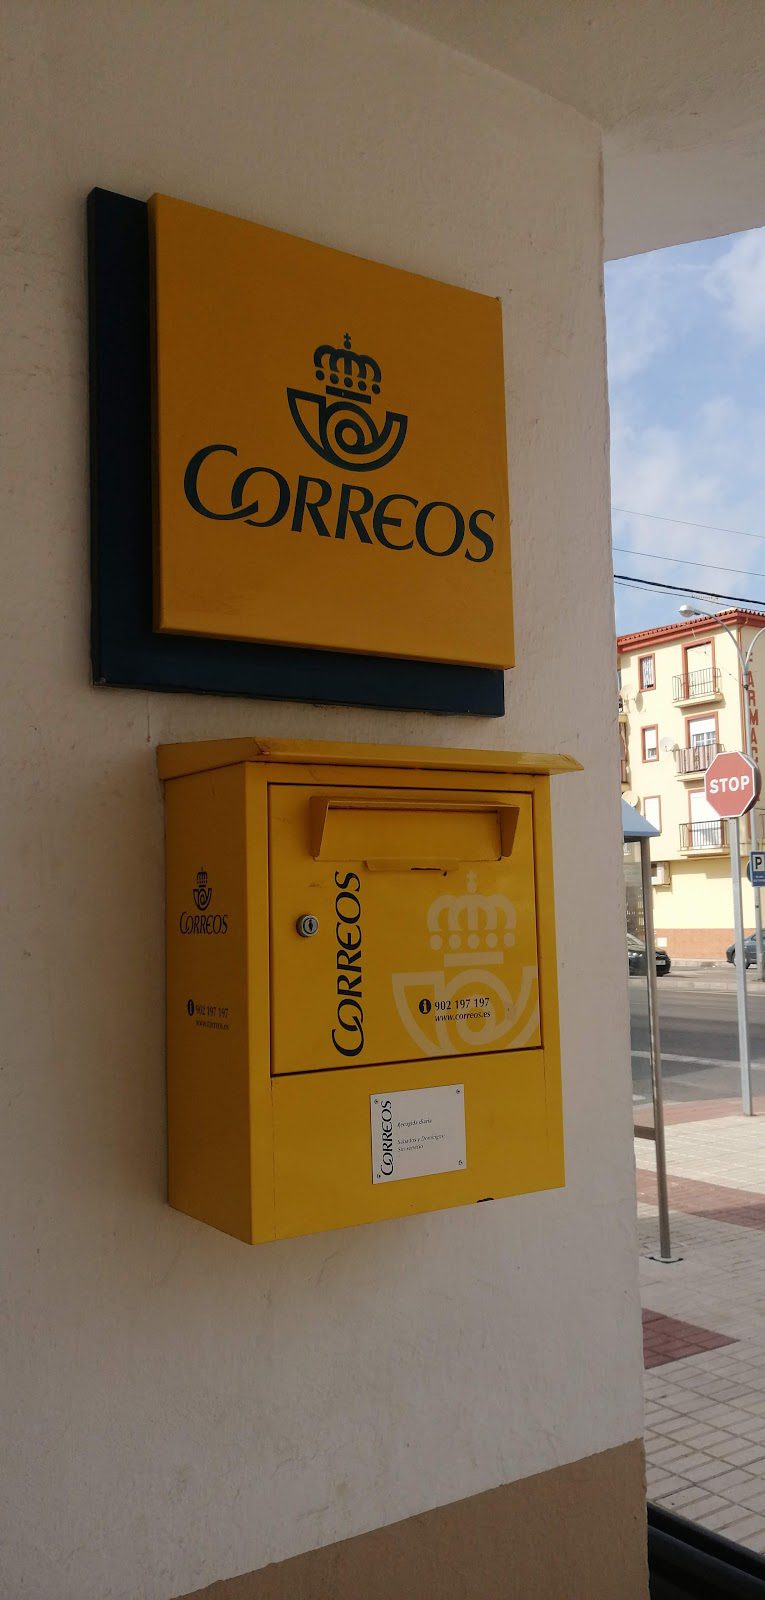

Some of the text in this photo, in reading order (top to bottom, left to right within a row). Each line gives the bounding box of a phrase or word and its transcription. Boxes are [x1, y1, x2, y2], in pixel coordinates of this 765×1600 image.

[183, 444, 496, 563] CORREOS
[709, 775, 750, 794] STOP
[755, 856, 763, 870] P
[179, 911, 229, 935] CORREOS
[332, 870, 365, 1057] CORREOS
[434, 997, 490, 1012] 902 197 197
[434, 1010, 492, 1023] www.correos.es
[380, 1100, 394, 1176] CORREOS
